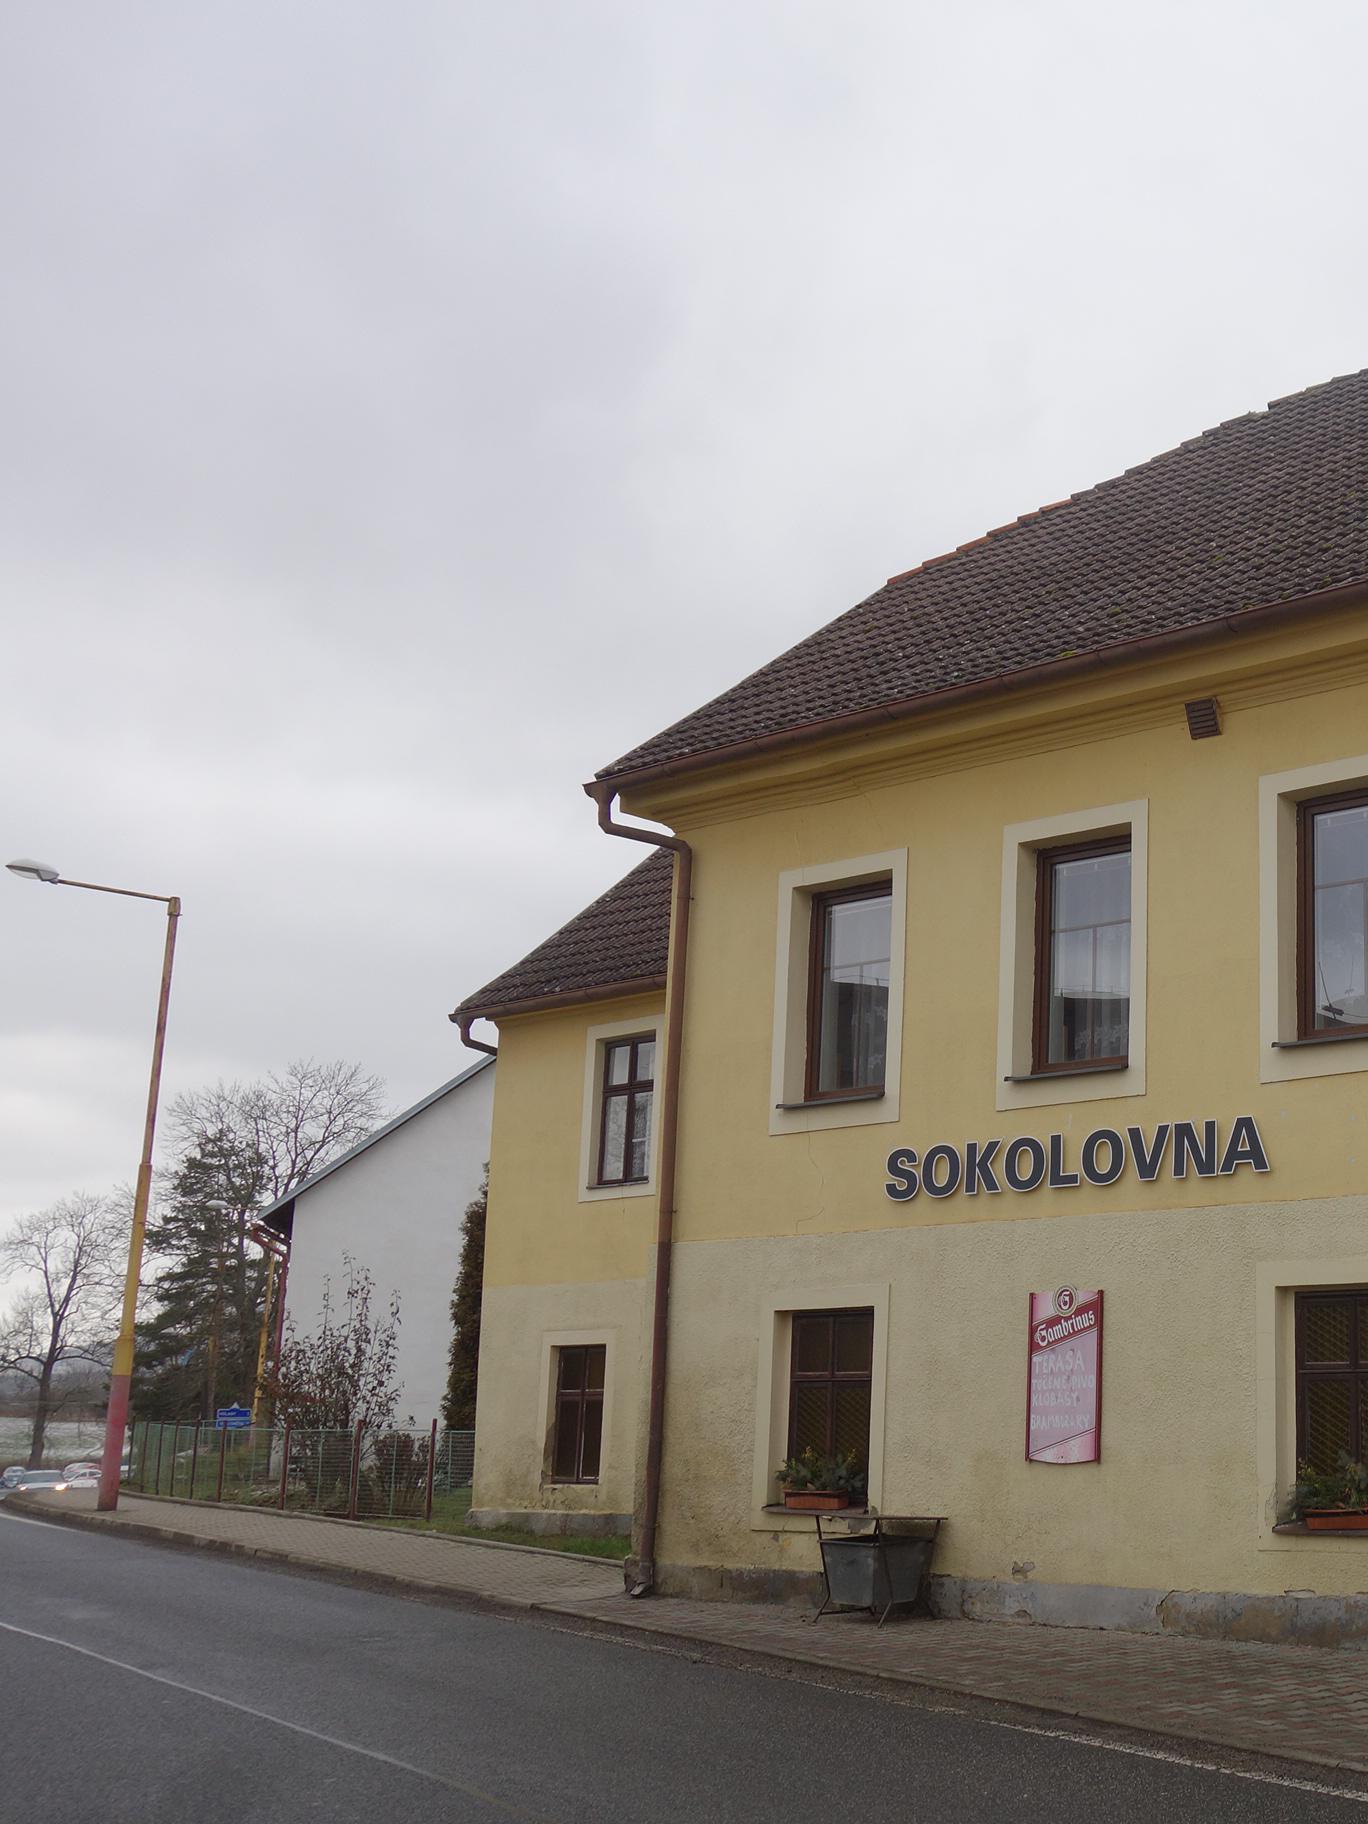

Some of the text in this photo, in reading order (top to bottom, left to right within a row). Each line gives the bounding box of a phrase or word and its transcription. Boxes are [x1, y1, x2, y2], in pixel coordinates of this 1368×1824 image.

[885, 1115, 1271, 1201] SOKOLOVNA
[1034, 1310, 1096, 1347] Gambrinus
[1033, 1349, 1086, 1375] TERASA
[1071, 1374, 1096, 1391] PIVO
